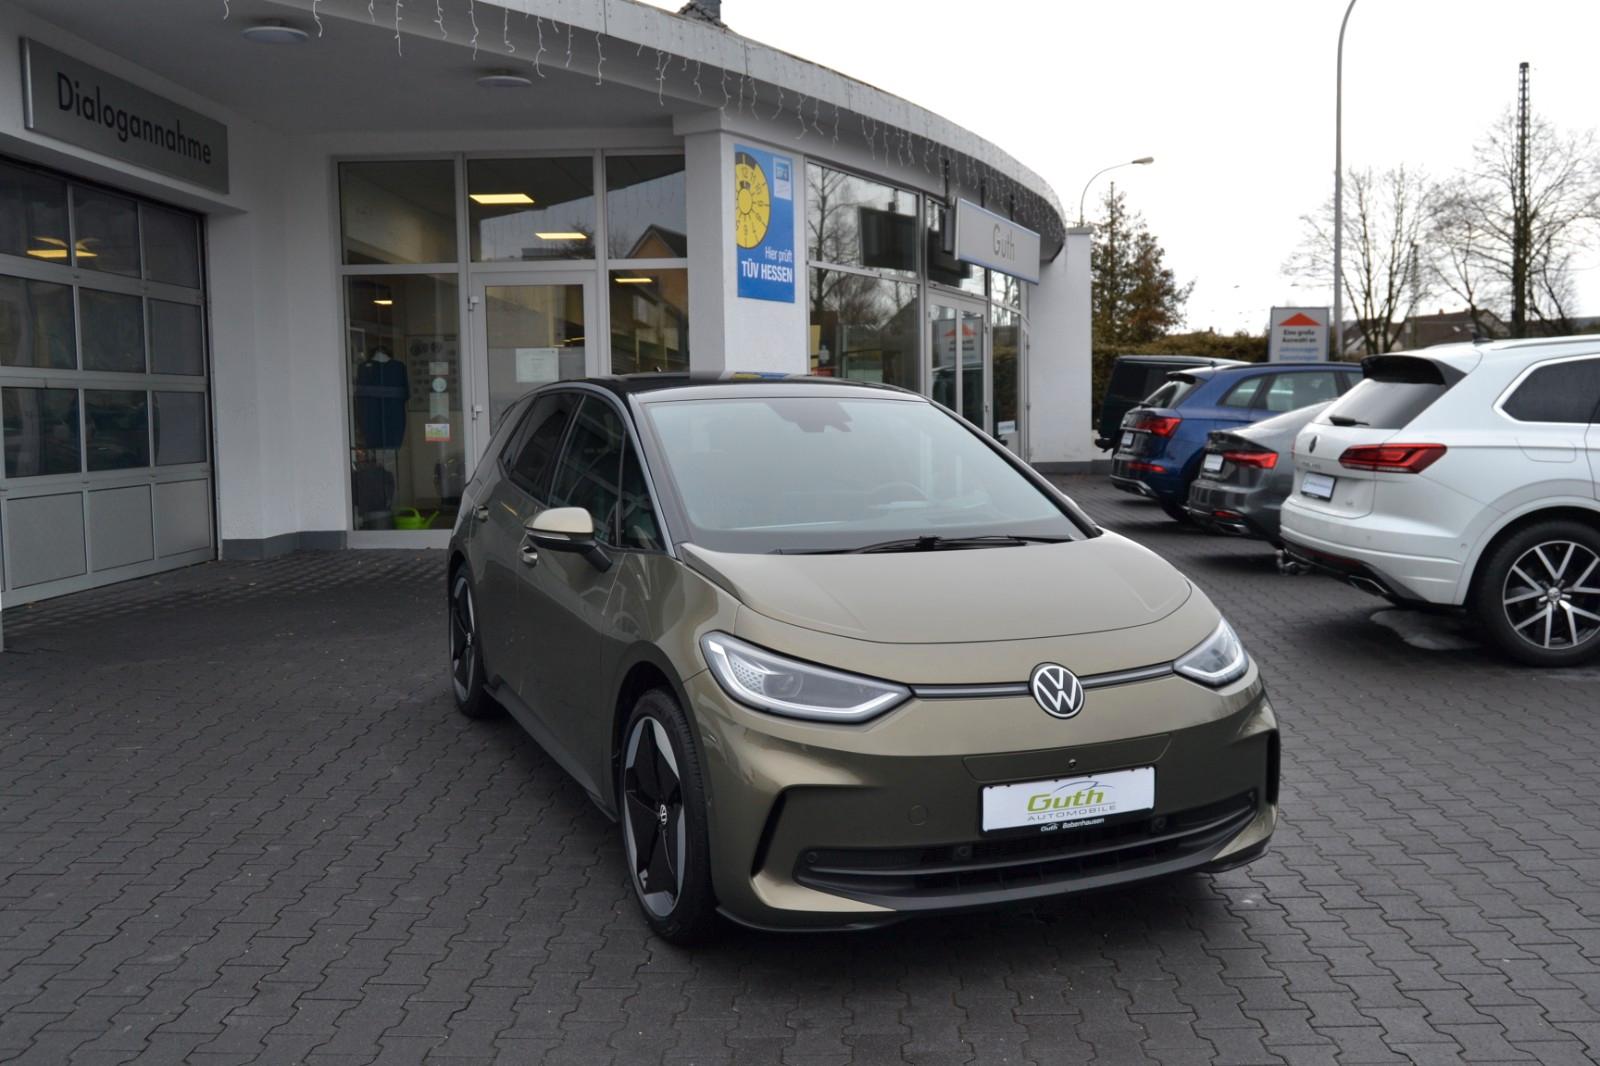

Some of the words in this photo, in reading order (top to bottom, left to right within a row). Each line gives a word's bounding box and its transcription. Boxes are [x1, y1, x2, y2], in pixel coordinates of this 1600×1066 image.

[57, 71, 212, 165] Dialogannahme
[765, 246, 777, 260] Hier
[778, 249, 792, 263] prüft
[993, 223, 1015, 263] Guth
[741, 258, 759, 279] TÜV
[761, 263, 793, 283] HESSEN
[1027, 789, 1105, 813] Guth
[1027, 804, 1117, 822] AUTOMOBILE
